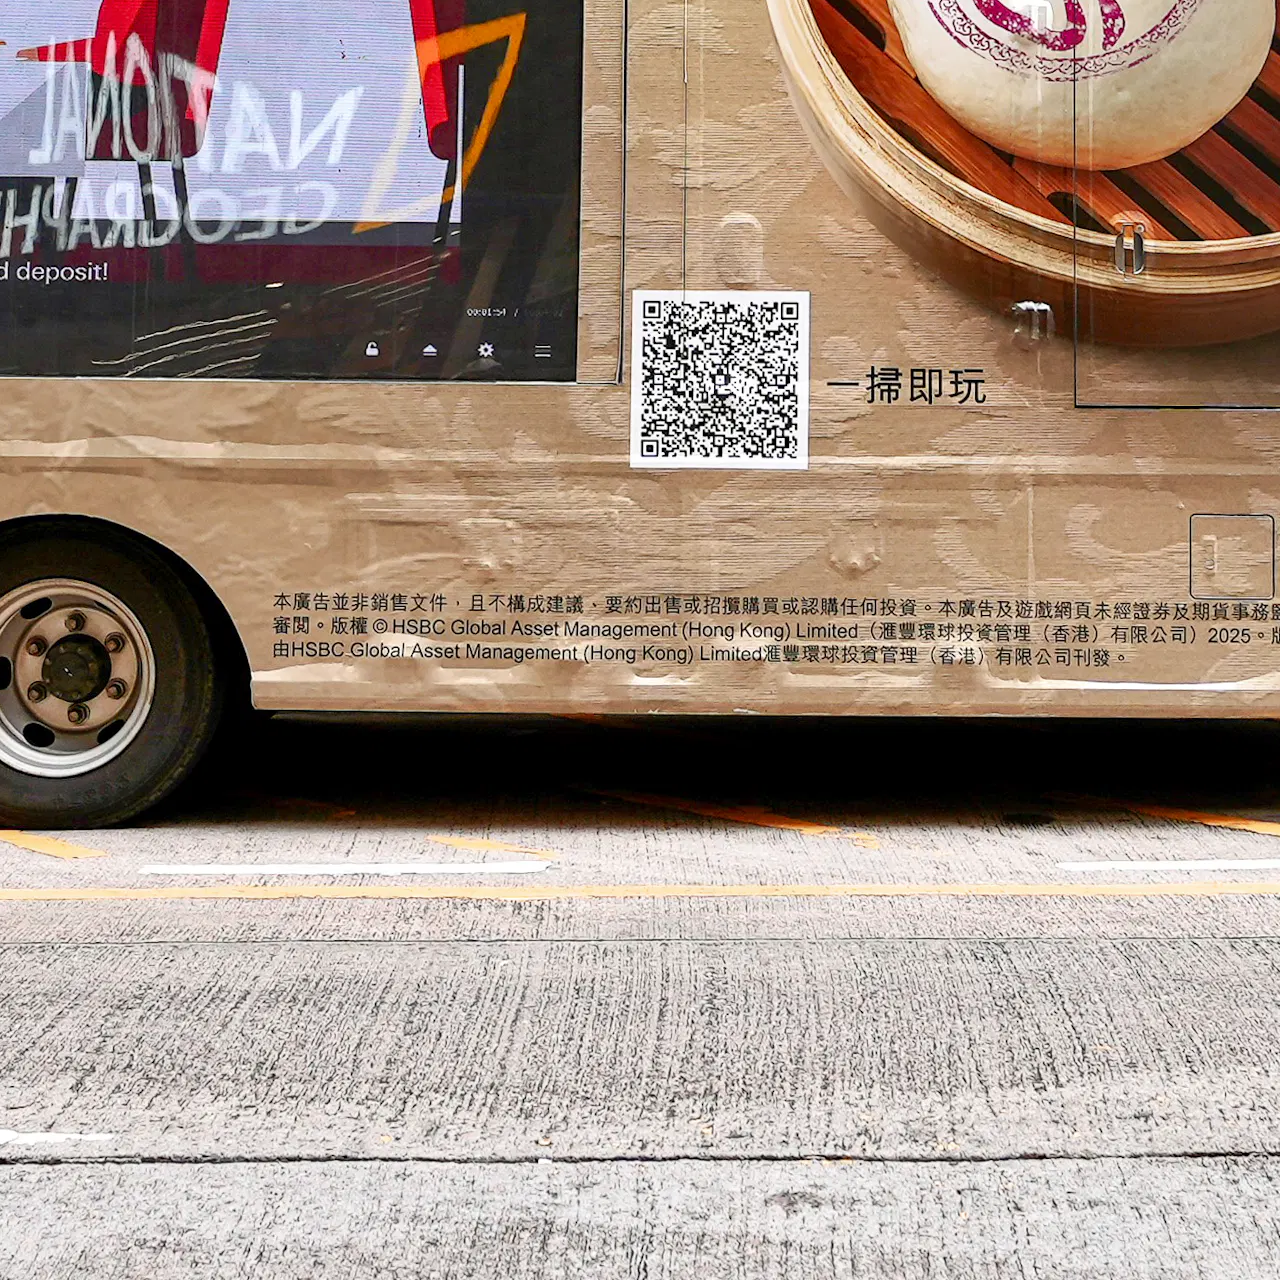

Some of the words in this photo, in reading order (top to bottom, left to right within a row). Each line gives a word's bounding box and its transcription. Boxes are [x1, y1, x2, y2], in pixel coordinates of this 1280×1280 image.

[16, 260, 109, 284] deposit!
[826, 365, 987, 405] 一掃即玩
[393, 619, 446, 636] HSBC
[451, 619, 507, 636] Global
[511, 620, 559, 637] Asset
[563, 620, 678, 641] Management
[682, 621, 735, 641] (Hong
[740, 621, 792, 642] Kong)
[797, 622, 858, 640] Limited
[351, 642, 406, 659] Global
[410, 643, 461, 660] Asset
[465, 643, 579, 664] Management
[583, 644, 637, 665] (Hong
[642, 644, 694, 665] Kong)
